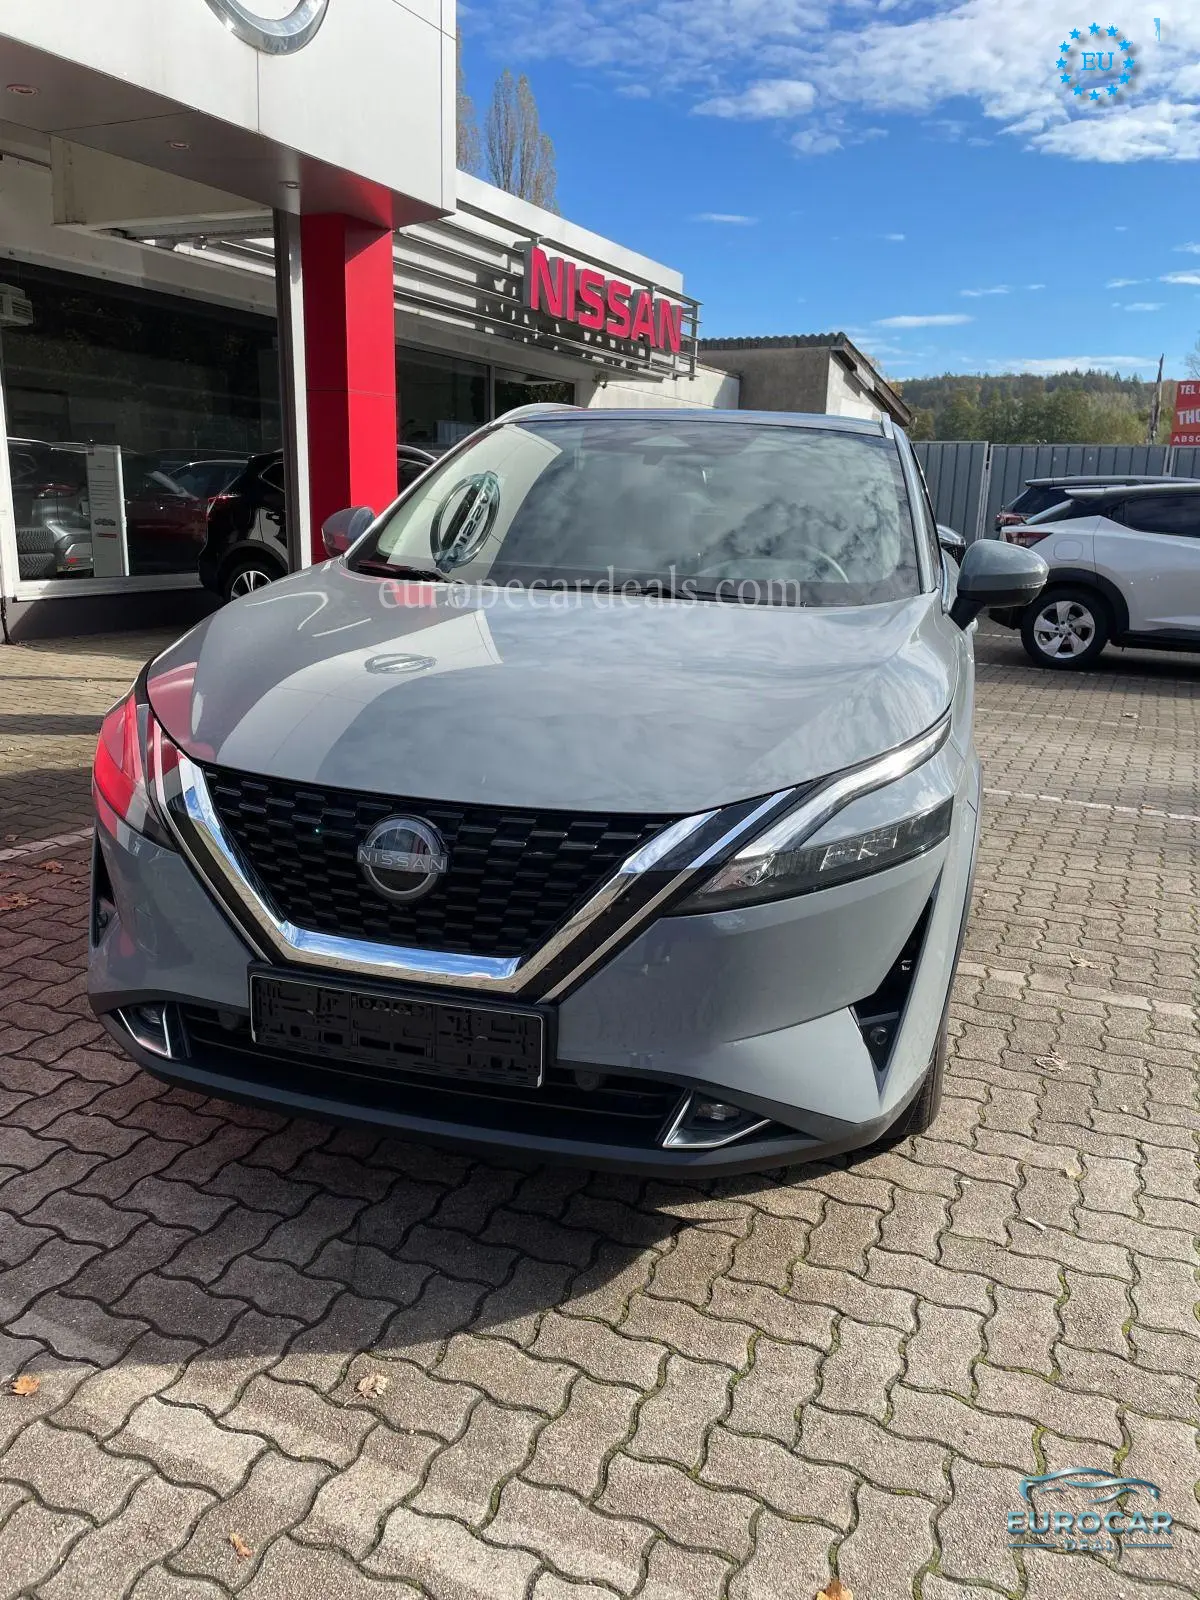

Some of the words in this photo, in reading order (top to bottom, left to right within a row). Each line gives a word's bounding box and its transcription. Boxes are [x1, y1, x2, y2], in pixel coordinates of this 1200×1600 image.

[529, 245, 682, 354] NISSAN
[1180, 384, 1196, 395] TEL
[359, 848, 444, 871] NISSAN
